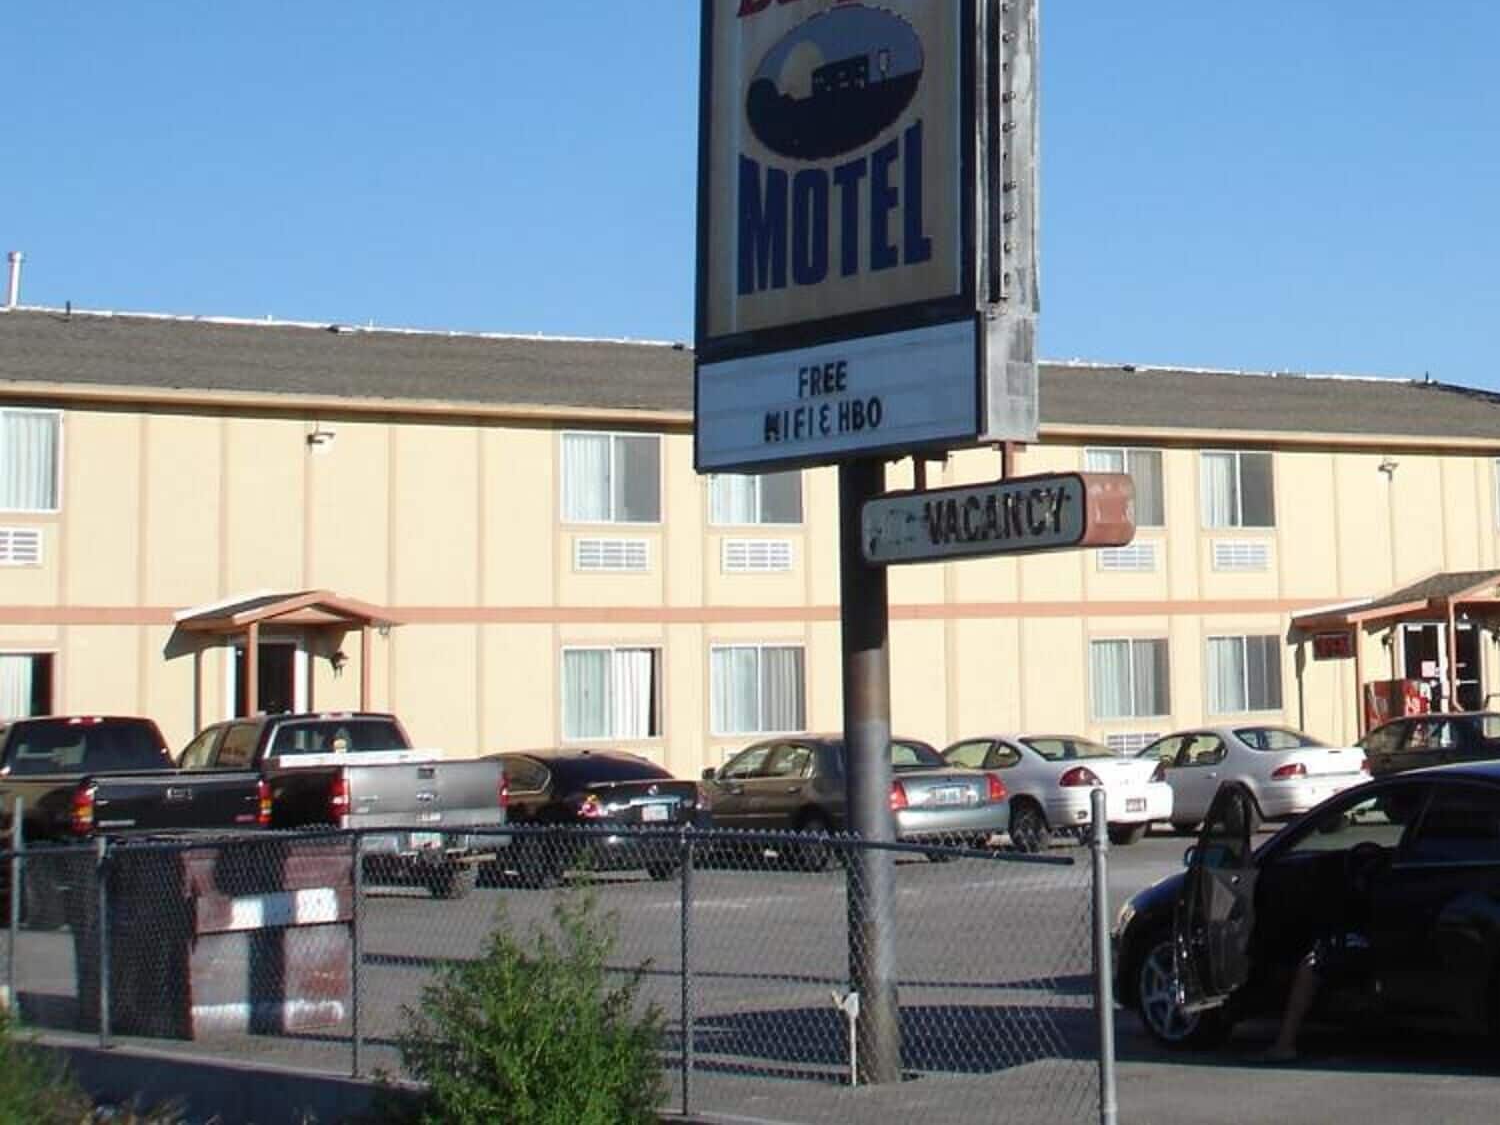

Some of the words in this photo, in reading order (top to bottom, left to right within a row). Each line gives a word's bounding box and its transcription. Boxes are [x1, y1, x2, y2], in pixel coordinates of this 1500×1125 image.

[737, 118, 932, 296] MOTEL
[797, 360, 848, 397] FREE
[837, 395, 883, 432] HBO
[924, 486, 1070, 545] VACANCY
